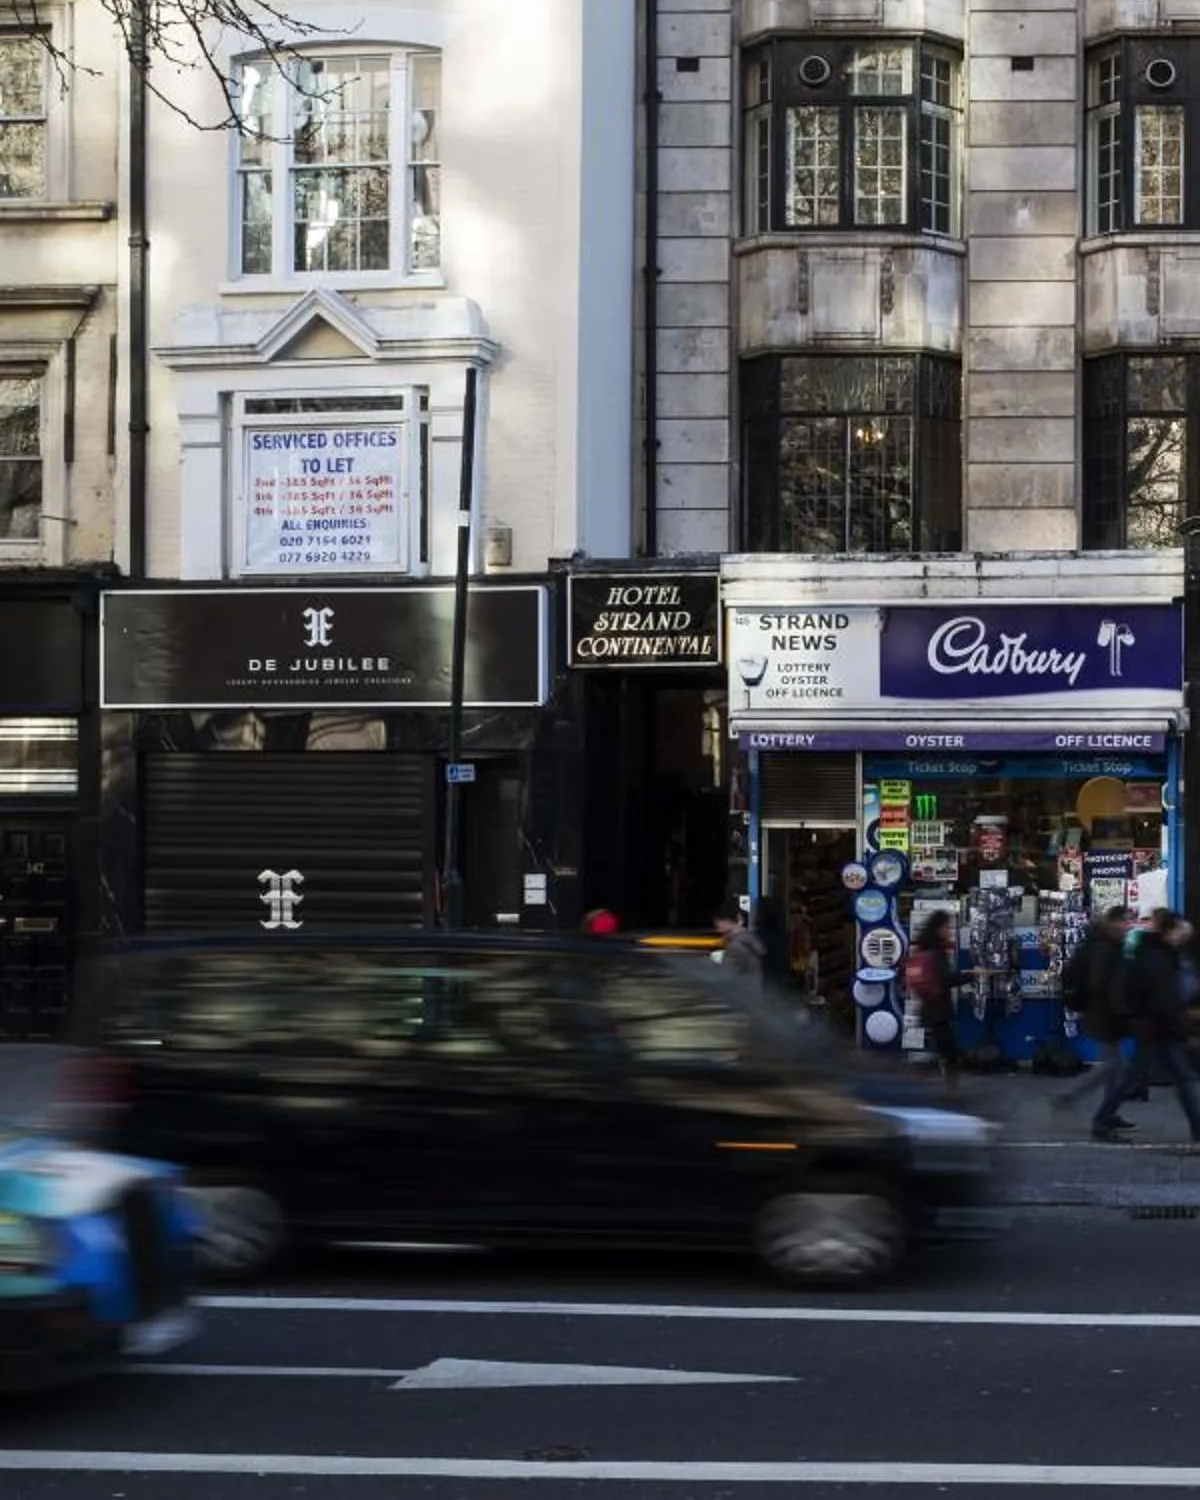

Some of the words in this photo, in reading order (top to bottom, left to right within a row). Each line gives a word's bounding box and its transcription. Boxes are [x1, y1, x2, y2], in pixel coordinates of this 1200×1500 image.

[253, 433, 327, 450] SERVICED
[333, 431, 397, 448] OFFICES
[301, 458, 321, 474] TO
[327, 457, 355, 473] LET
[281, 518, 303, 531] ALL
[279, 535, 304, 547] 020
[606, 586, 682, 606] HOTEL
[593, 610, 692, 632] STRAND
[758, 613, 850, 631] STRAND
[576, 635, 714, 658] CONTINENTAL
[771, 634, 838, 651] NEWS
[926, 615, 1087, 687] Cadbury
[248, 658, 278, 672] DE
[289, 656, 390, 672] JUBILEE
[777, 662, 832, 674] LOTTERY
[781, 674, 829, 686] OYSTER
[765, 687, 789, 699] OFF
[792, 687, 845, 699] LICENCE
[750, 733, 816, 748] LOTTERY
[905, 734, 965, 748] OYSTER
[1055, 734, 1084, 748] OFF
[1088, 734, 1153, 748] LICENCE
[908, 760, 944, 774] Ticket
[948, 760, 978, 776] Stop
[1062, 760, 1100, 774] Ticket
[1103, 761, 1133, 776] Stop
